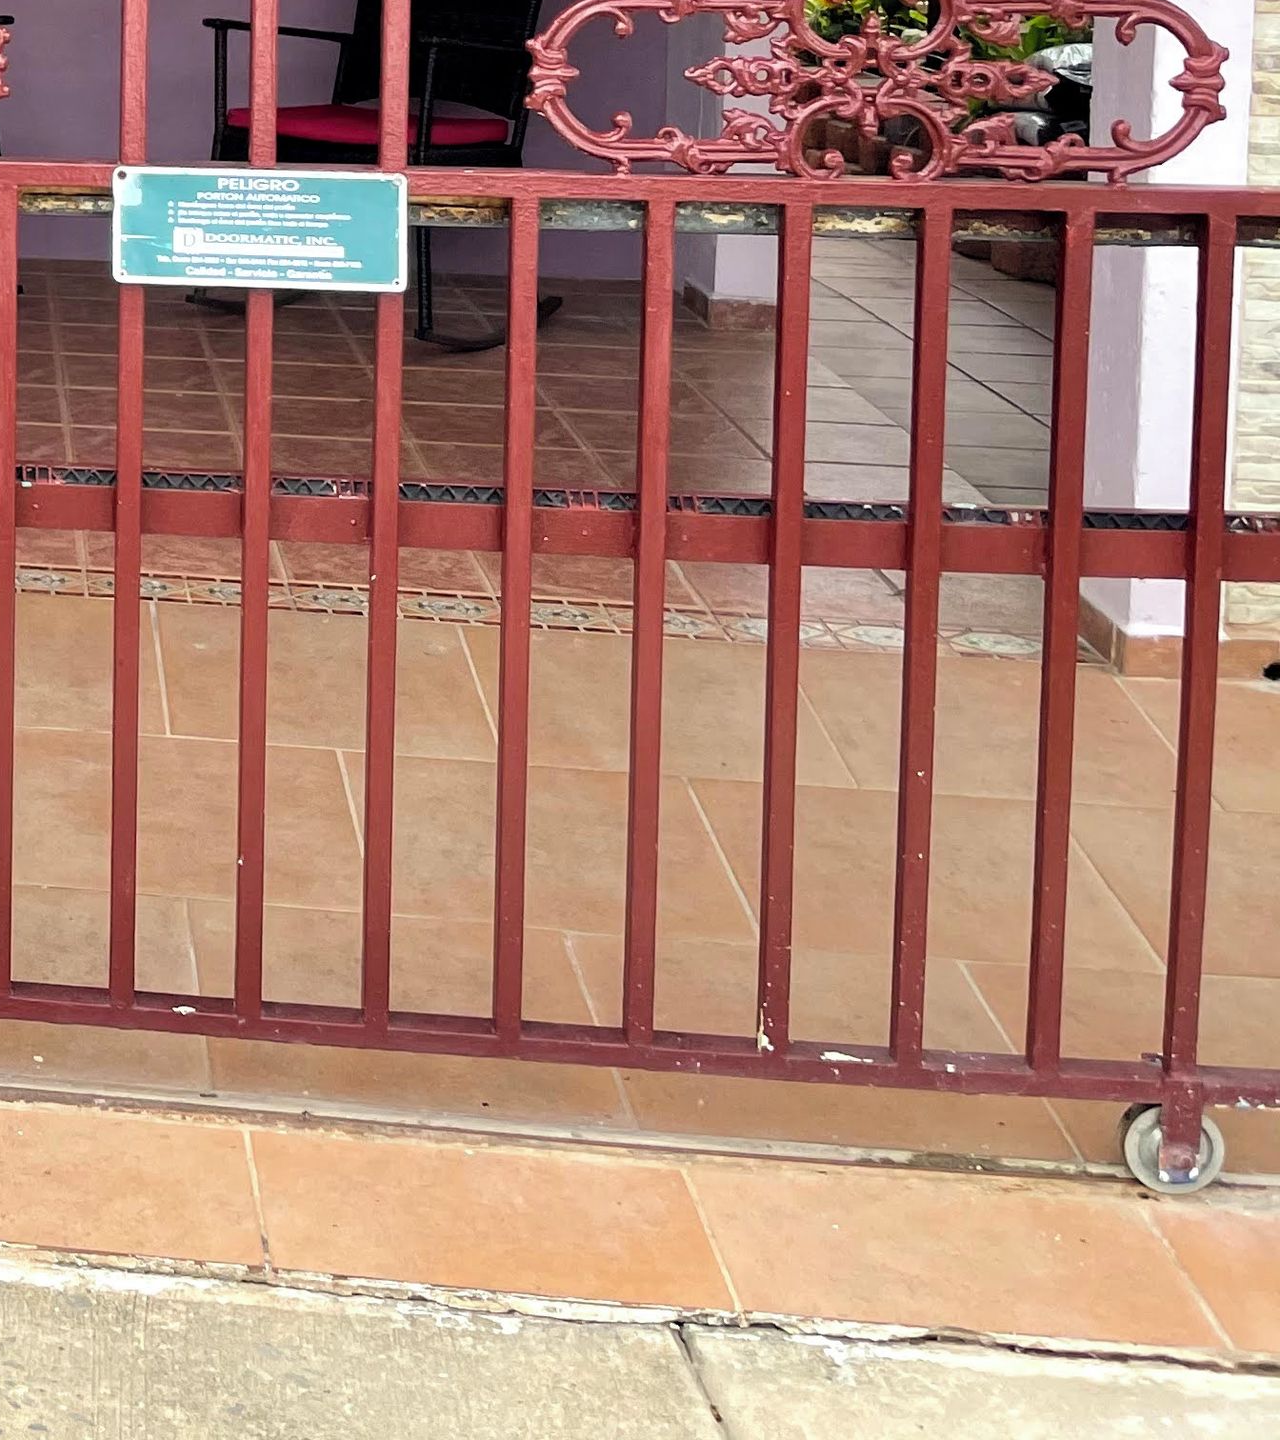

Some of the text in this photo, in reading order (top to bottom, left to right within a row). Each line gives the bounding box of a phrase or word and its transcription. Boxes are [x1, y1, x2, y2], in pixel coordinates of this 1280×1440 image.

[217, 177, 300, 192] PELIGRO
[196, 192, 320, 203] PORTON AUTOMATICO
[205, 233, 338, 246] DOORMATIC, INC.
